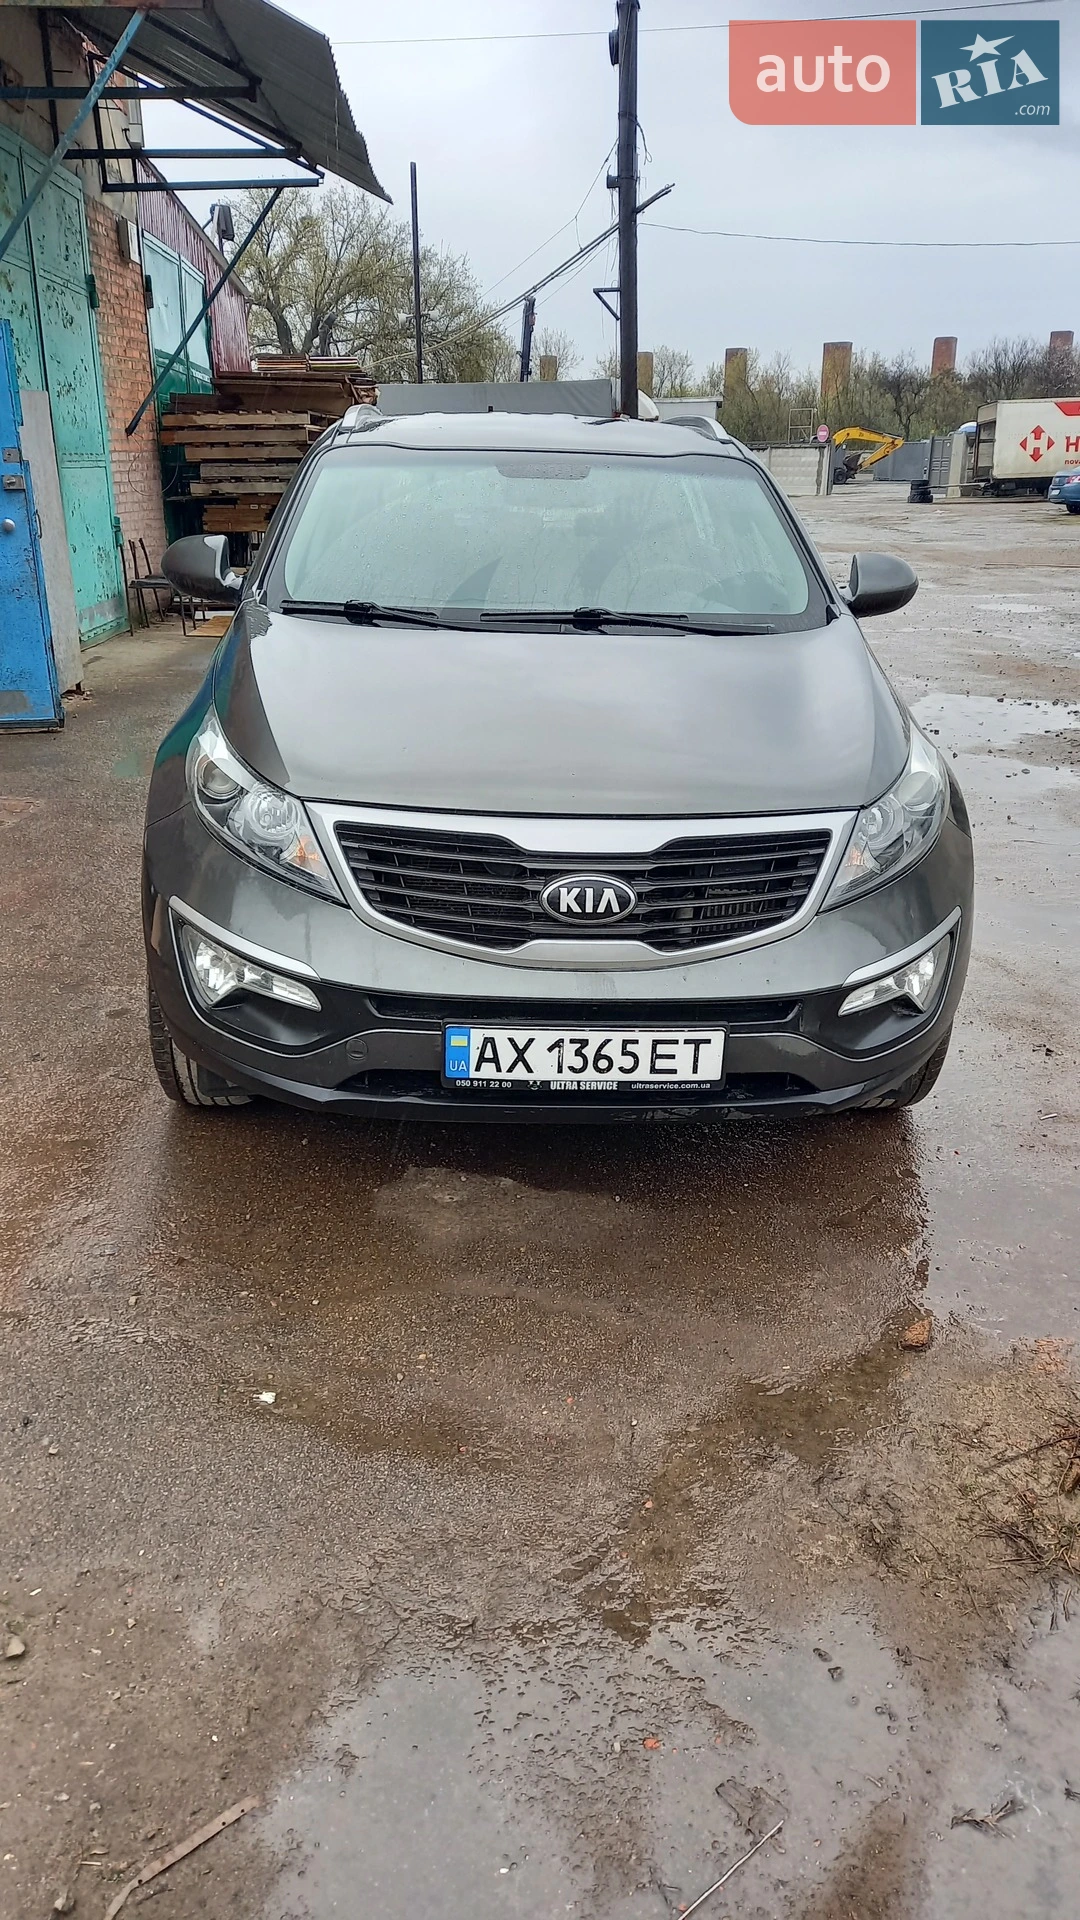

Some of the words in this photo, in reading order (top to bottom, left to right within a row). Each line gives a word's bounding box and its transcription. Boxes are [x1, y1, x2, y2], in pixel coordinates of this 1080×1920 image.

[559, 887, 620, 913] KIA
[474, 1036, 535, 1074] AX
[546, 1038, 640, 1075] 1365
[650, 1038, 712, 1075] ET
[450, 1060, 468, 1072] UA
[472, 1080, 487, 1088] 911
[489, 1080, 500, 1088] 22
[550, 1081, 578, 1090] ULTRA
[579, 1081, 618, 1091] SERVICE
[631, 1082, 711, 1090] ultraservice.com.ua
